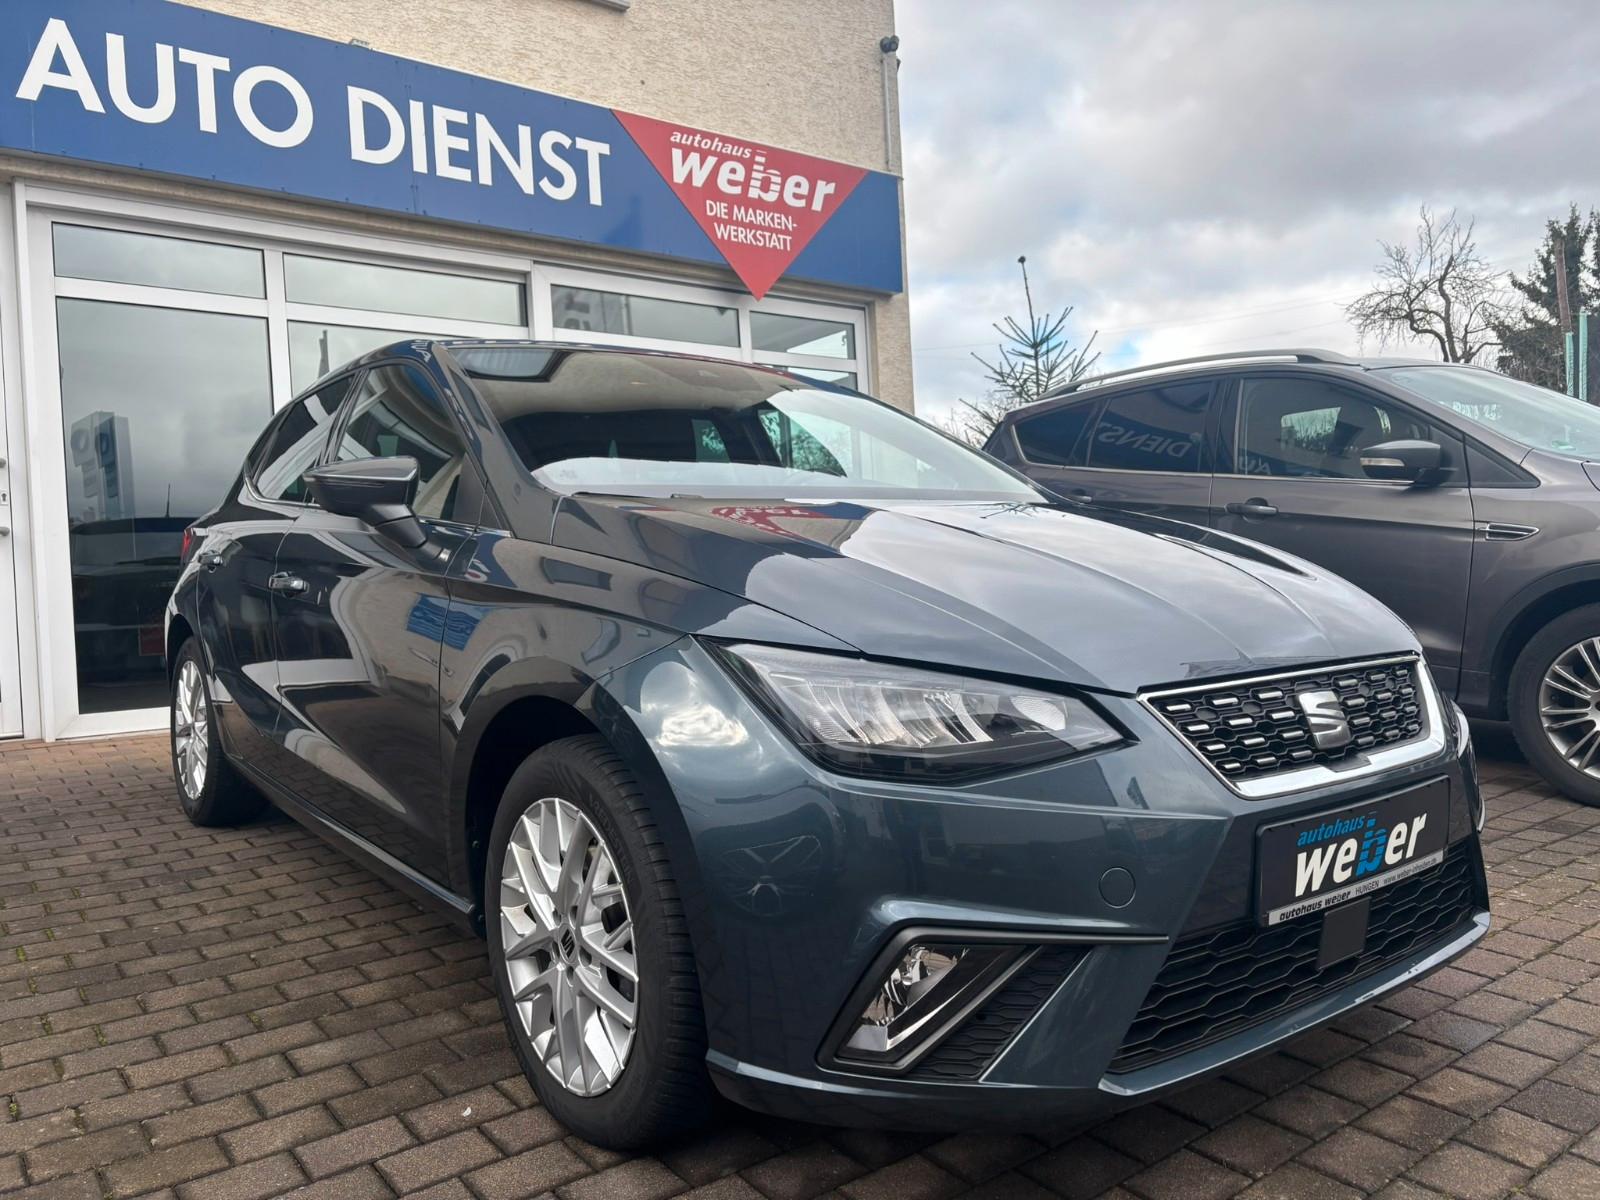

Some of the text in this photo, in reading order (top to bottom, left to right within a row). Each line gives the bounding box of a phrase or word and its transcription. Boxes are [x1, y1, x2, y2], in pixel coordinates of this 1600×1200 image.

[15, 17, 611, 207] AUTO DIENST
[669, 131, 752, 159] autohaus
[671, 147, 836, 212] weber
[706, 199, 798, 232] DIE MARKEN-
[714, 222, 792, 251] WERKSTATT
[1297, 815, 1366, 846] autohaus
[1294, 811, 1427, 897] weber
[1279, 900, 1322, 921] autohaus
[1324, 891, 1351, 906] weber
